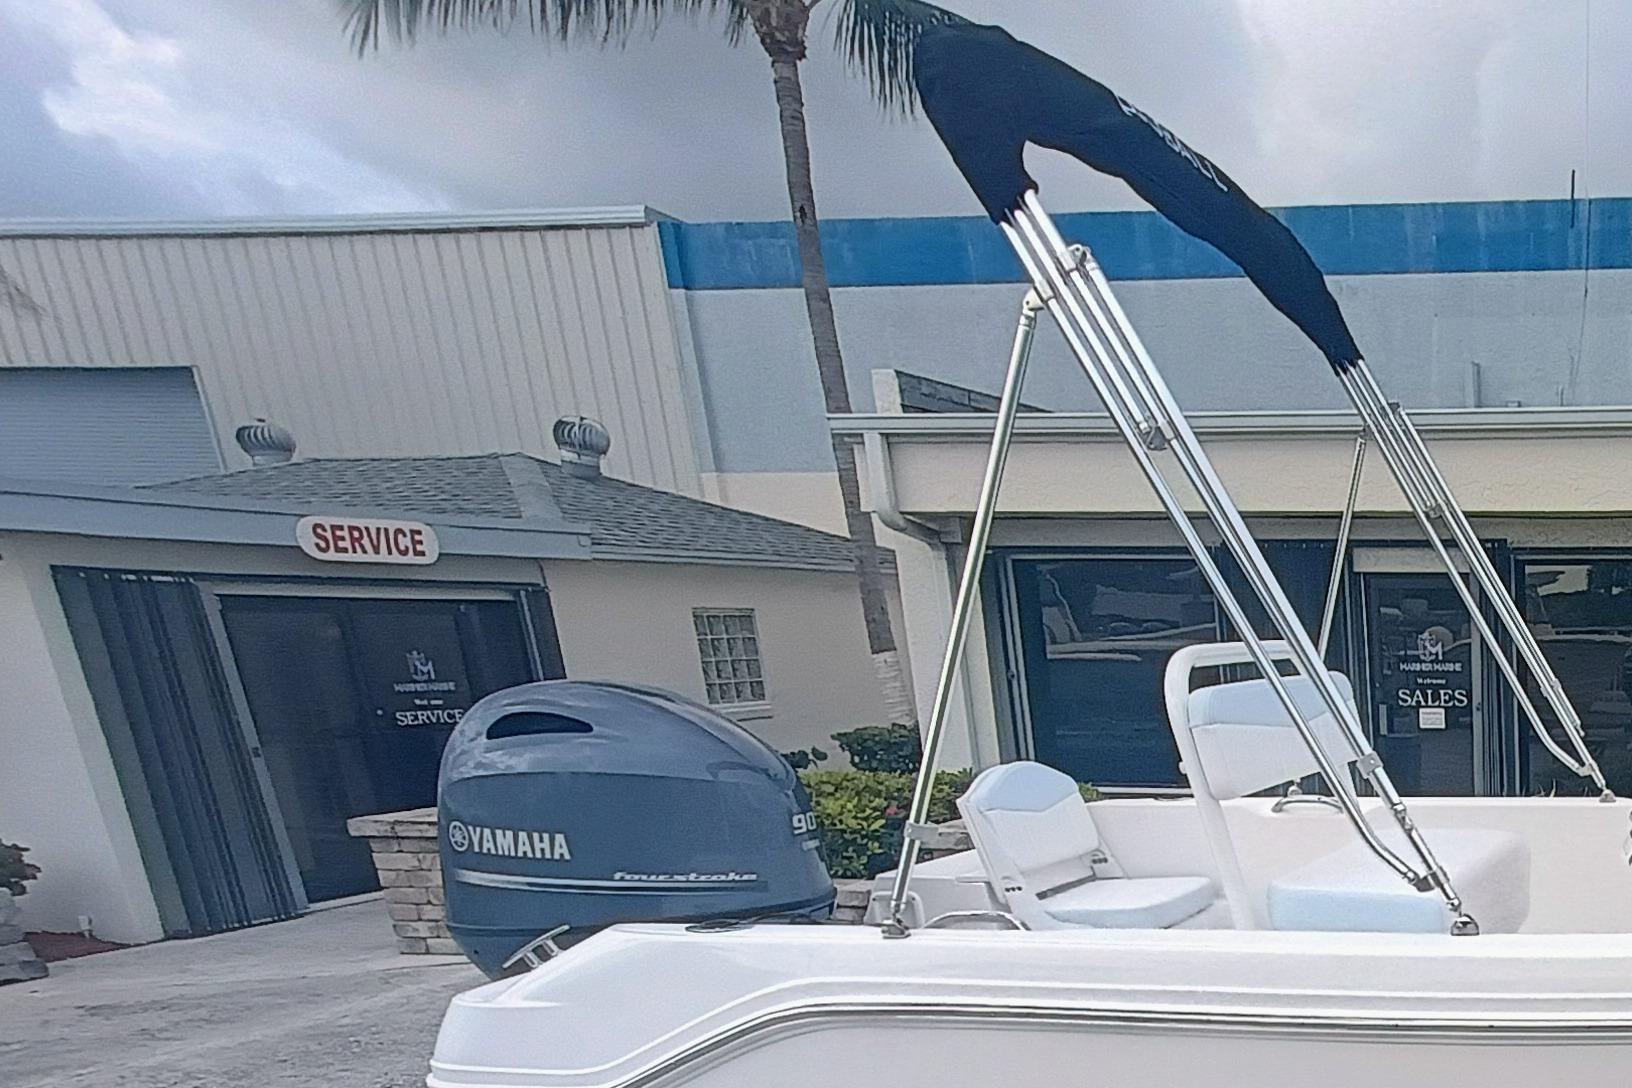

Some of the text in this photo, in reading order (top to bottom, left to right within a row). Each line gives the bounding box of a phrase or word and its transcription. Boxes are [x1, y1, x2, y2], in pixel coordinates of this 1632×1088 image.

[311, 522, 426, 557] SERVICE
[1398, 689, 1469, 707] SALES
[395, 708, 465, 727] SERVICE
[792, 811, 817, 835] 90
[467, 825, 572, 861] YAMAHA
